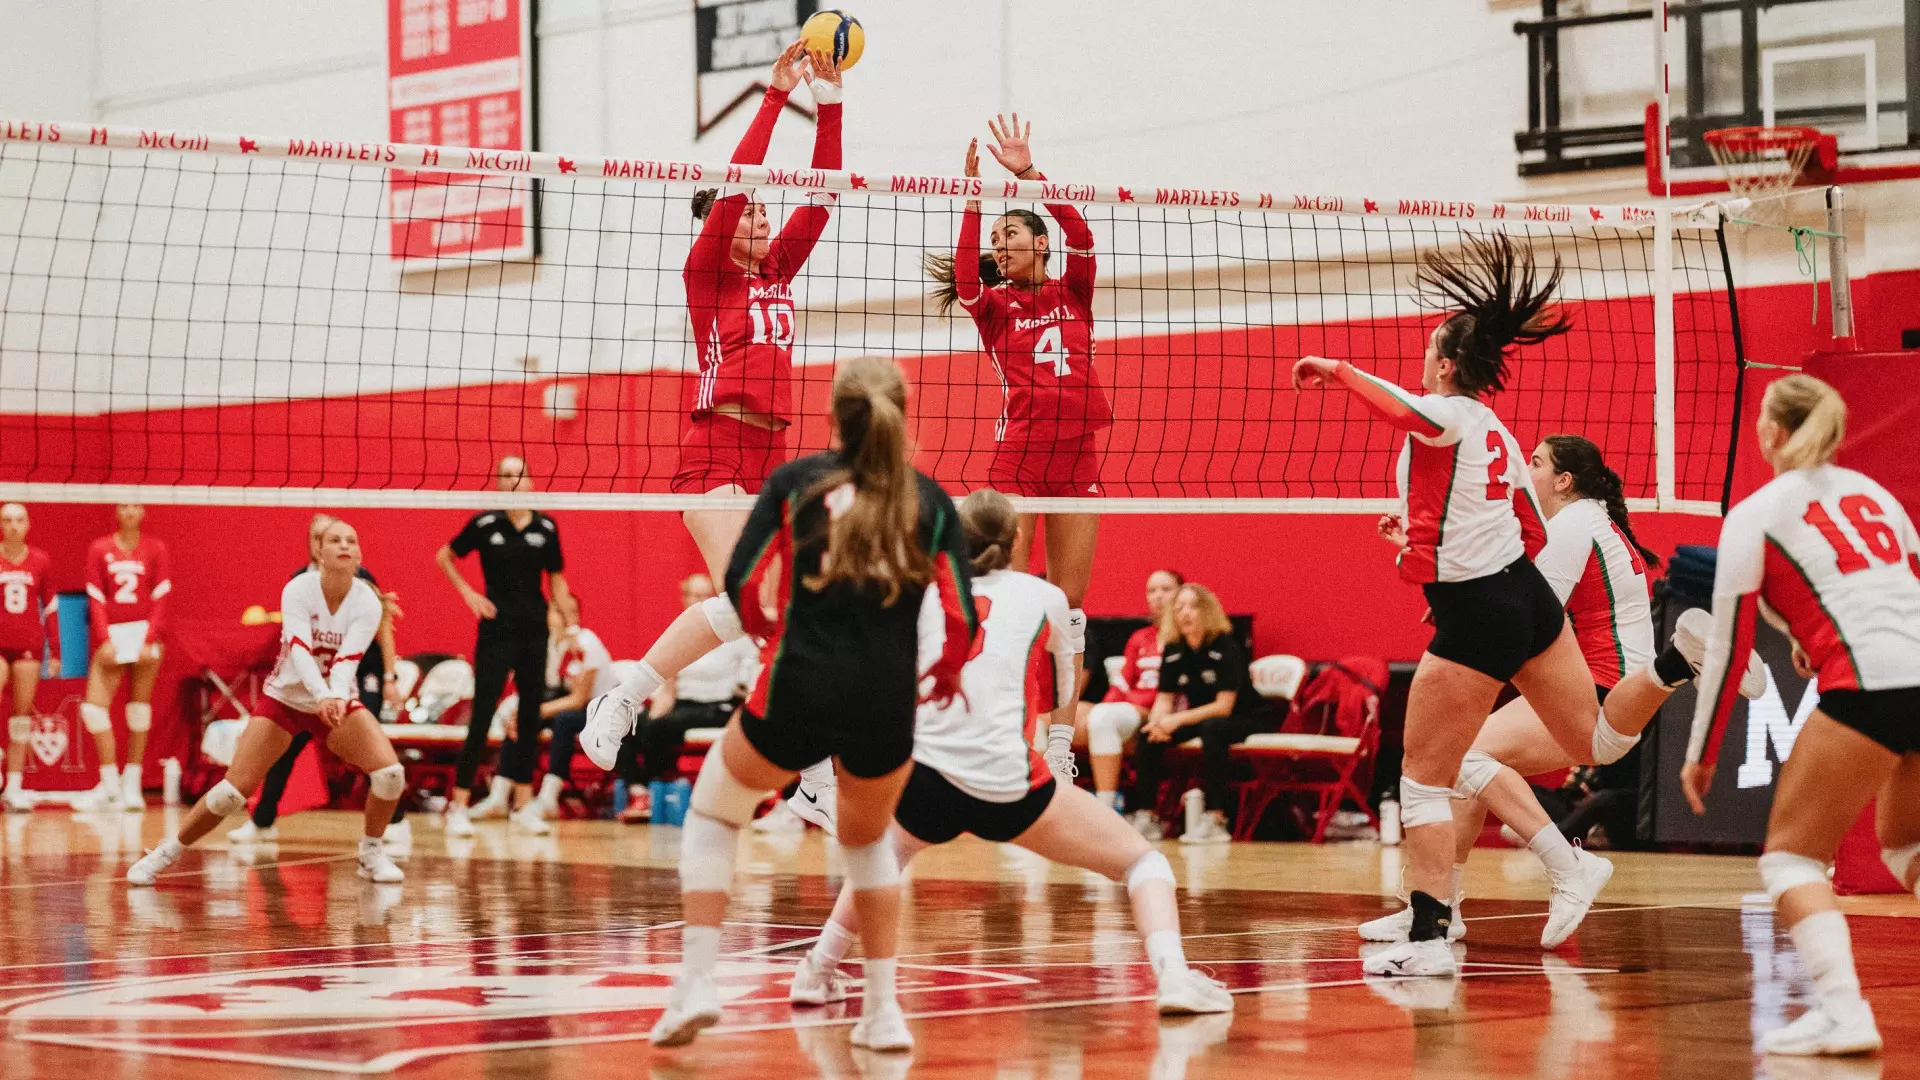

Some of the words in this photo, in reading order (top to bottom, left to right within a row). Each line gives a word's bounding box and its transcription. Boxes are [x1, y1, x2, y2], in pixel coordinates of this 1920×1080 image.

[137, 129, 209, 152] McGill
[287, 138, 397, 164] MARTLETS
[465, 151, 532, 173] McGill
[602, 158, 704, 182] MARTLETS
[765, 168, 827, 188] McGill
[890, 174, 983, 197] MARTLETS
[1040, 182, 1096, 202] McGill
[1154, 187, 1241, 208] MARTLETS
[1292, 194, 1344, 212] McGill
[1397, 199, 1475, 219] MARTLETS
[1523, 205, 1571, 223] McGill
[748, 301, 795, 352] 10
[1031, 325, 1071, 378] 4
[1485, 430, 1510, 501] 2
[1802, 493, 1903, 575] 16
[114, 571, 138, 604] 2
